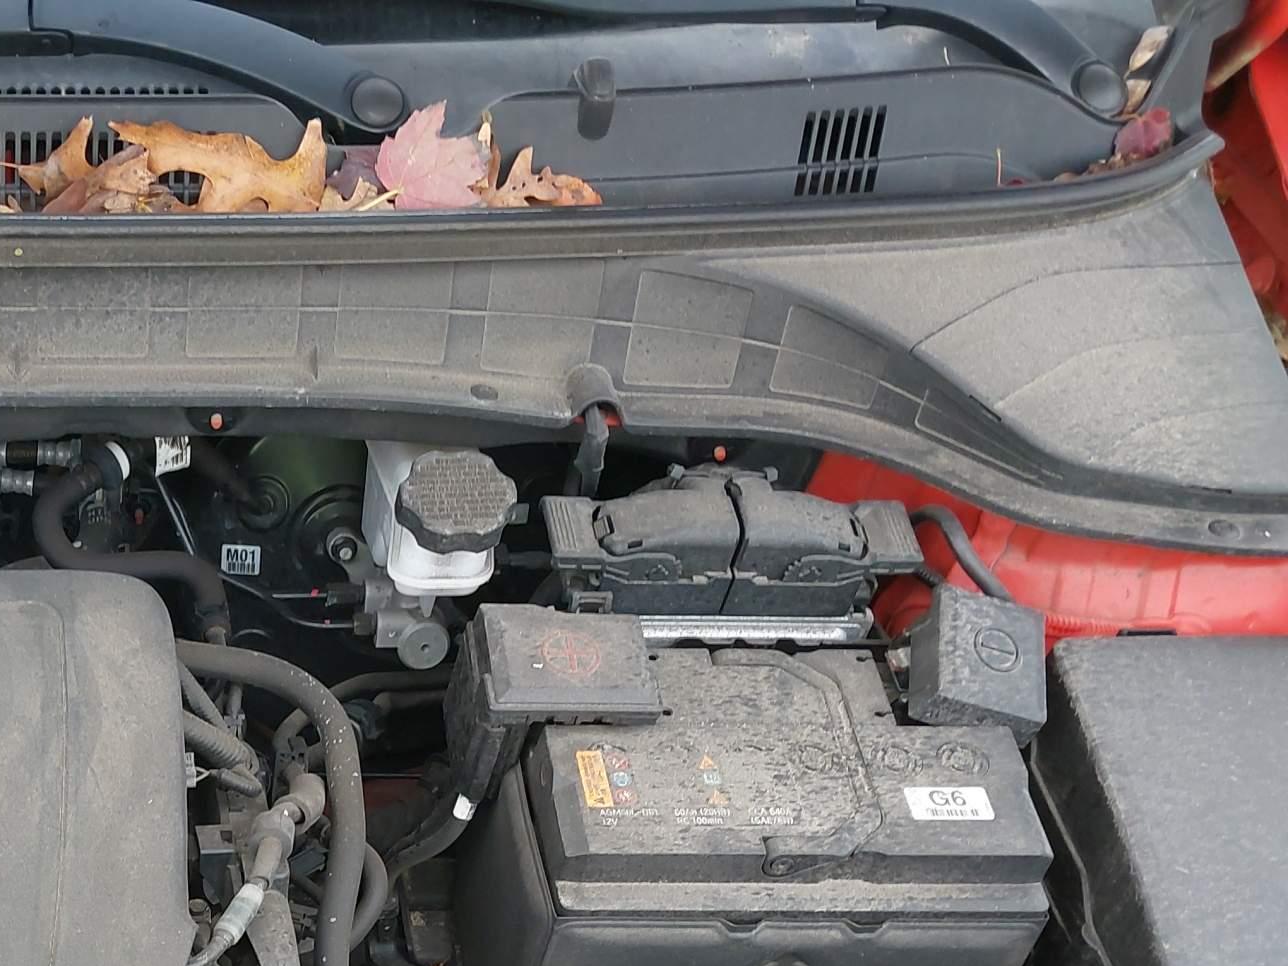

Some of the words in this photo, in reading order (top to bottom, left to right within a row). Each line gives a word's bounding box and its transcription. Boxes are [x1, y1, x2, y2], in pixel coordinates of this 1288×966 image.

[226, 548, 256, 563] M01
[928, 790, 967, 807] G6
[602, 818, 618, 827] 12V
[692, 817, 724, 825] 100min
